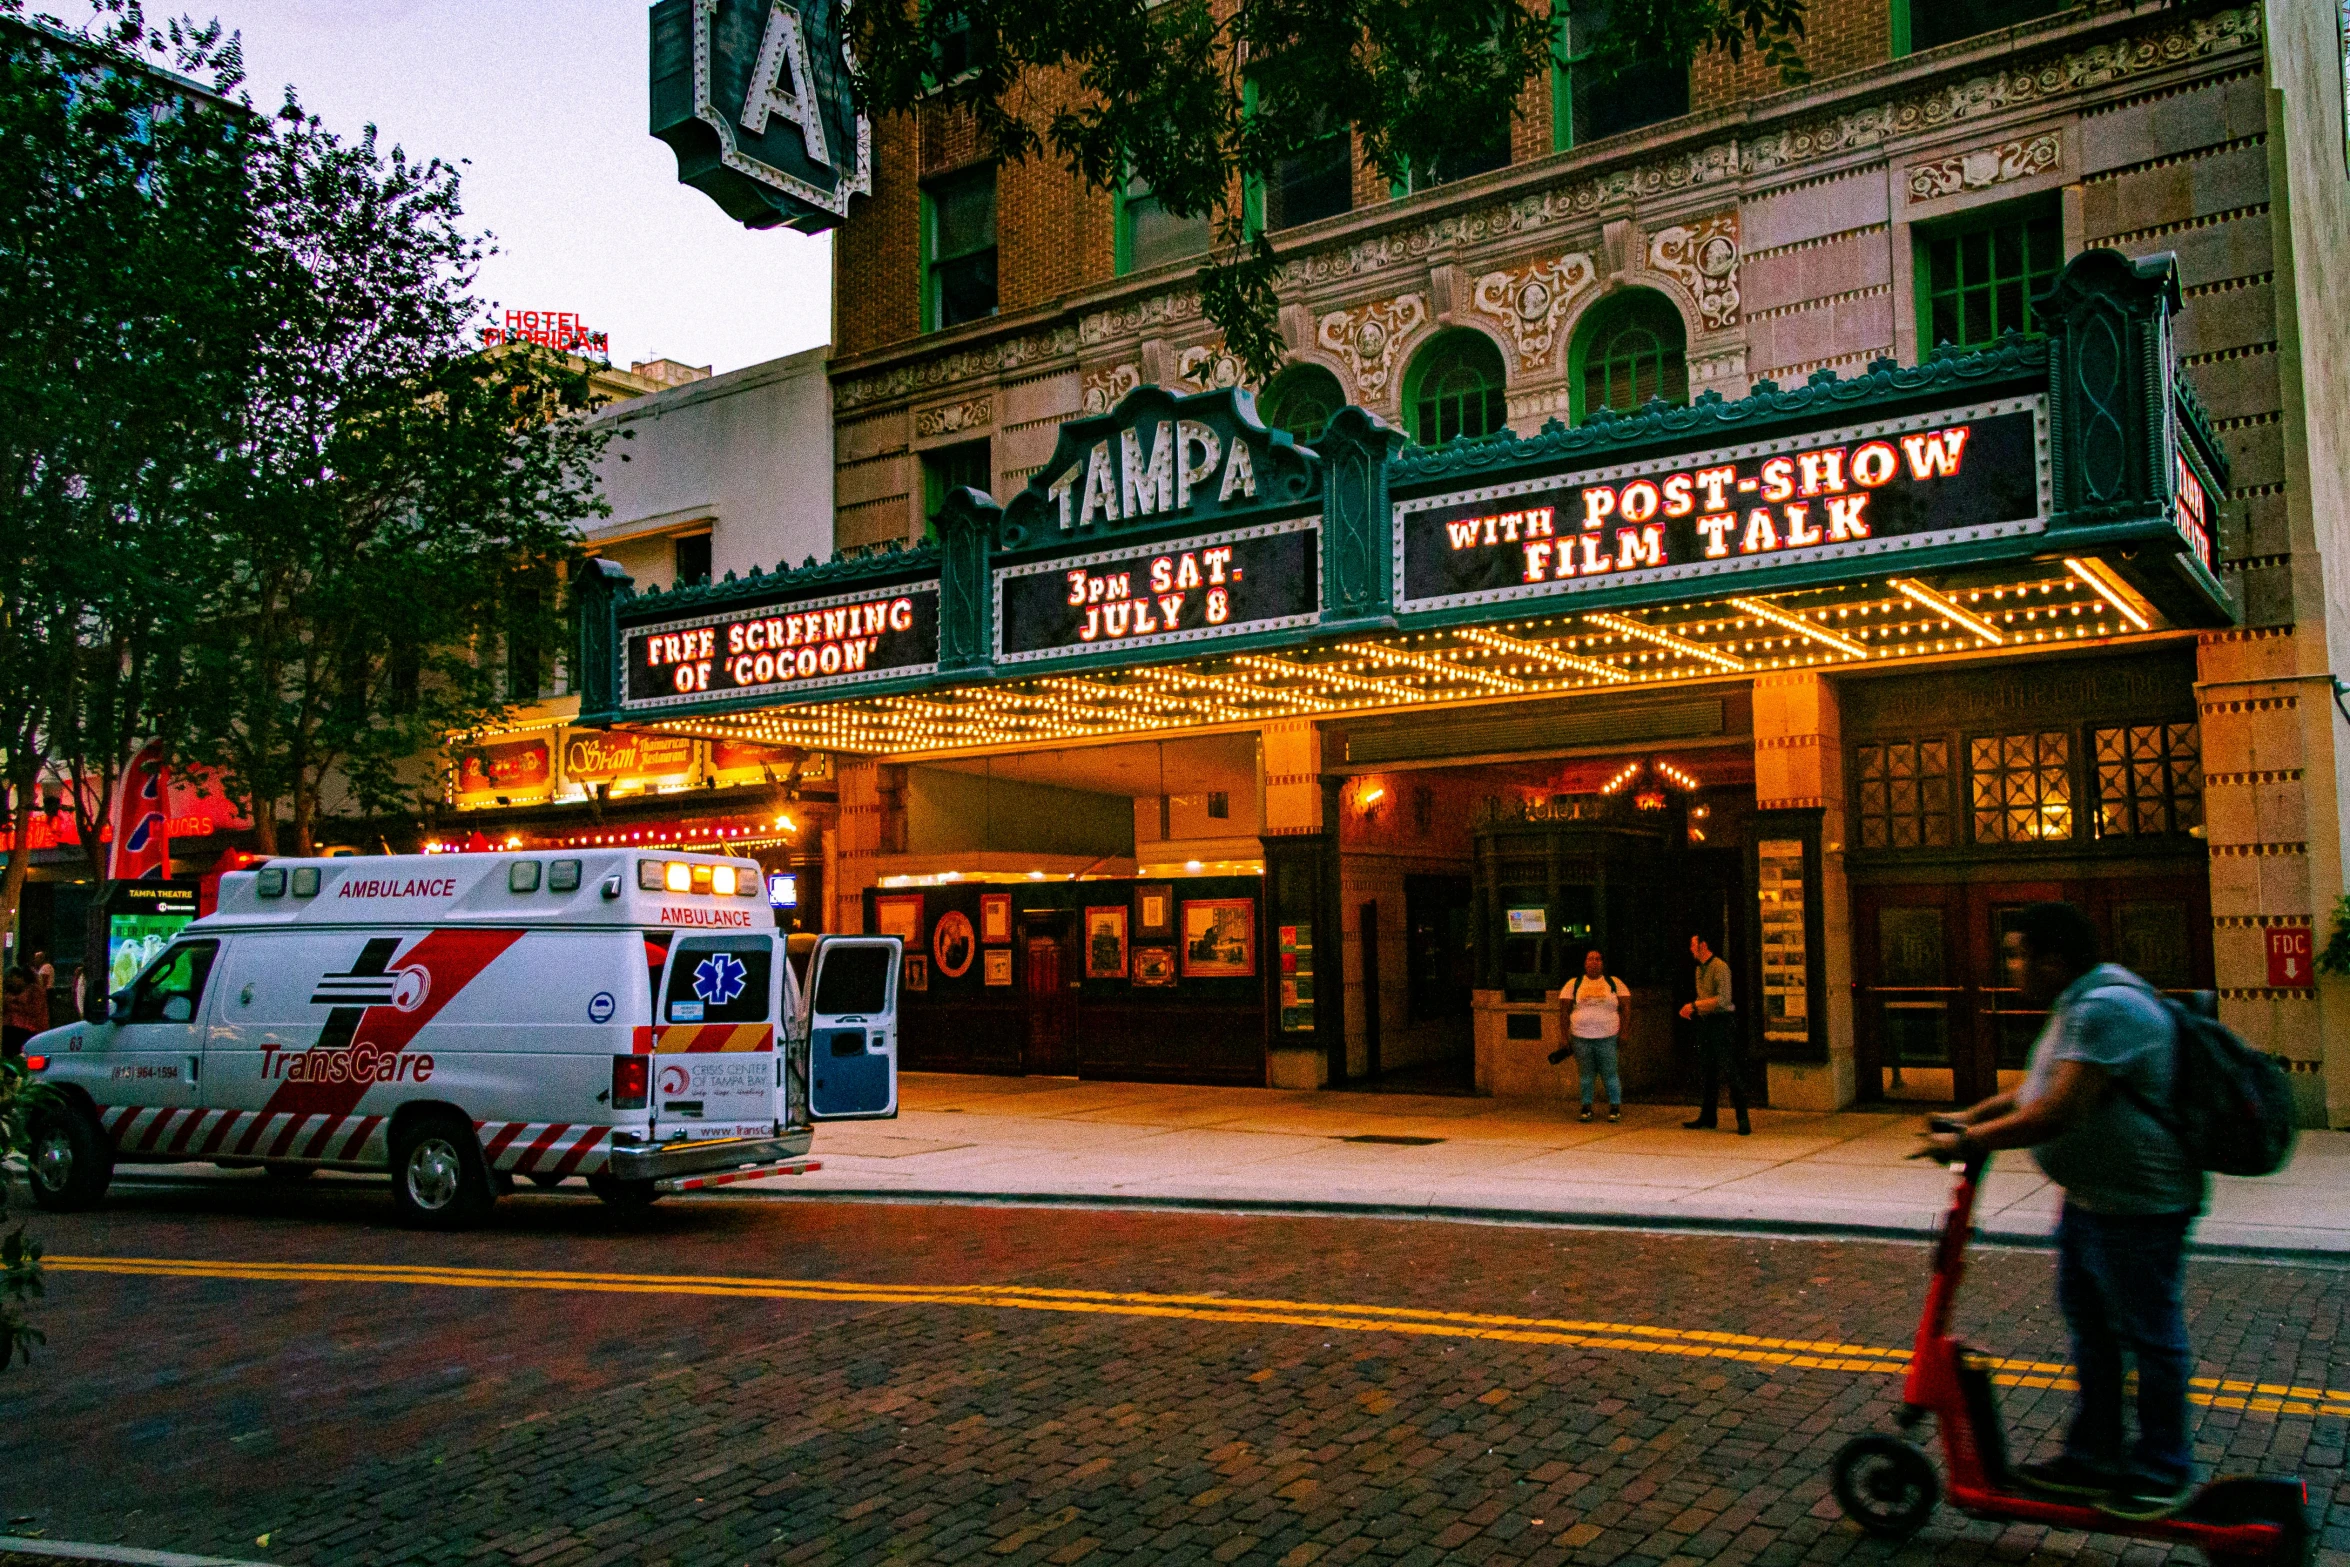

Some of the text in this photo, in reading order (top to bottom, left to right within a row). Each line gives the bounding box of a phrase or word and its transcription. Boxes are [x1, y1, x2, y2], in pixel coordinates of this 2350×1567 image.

[740, 0, 831, 166] A
[506, 310, 588, 331] HOTEL
[1048, 420, 1256, 530] TAMPA
[1446, 427, 1970, 550] WITH POST-SHOW
[1523, 492, 1870, 582] FILM TALK
[1150, 546, 1243, 593] SAT.
[647, 597, 912, 667] FREE SCREENING
[1079, 586, 1229, 642] JULY 8
[674, 636, 878, 693] OF 'COCOON'
[129, 889, 193, 899] TAMPA THEATRE
[339, 879, 456, 899] AMBULANCE
[660, 908, 751, 927] AMBULANCE
[2272, 934, 2305, 954] FDC
[69, 1036, 83, 1052] 63
[260, 1042, 434, 1082] TransCare
[692, 1063, 767, 1076] CRISIS CENTER
[692, 1076, 766, 1087] OF TAMPA BAY
